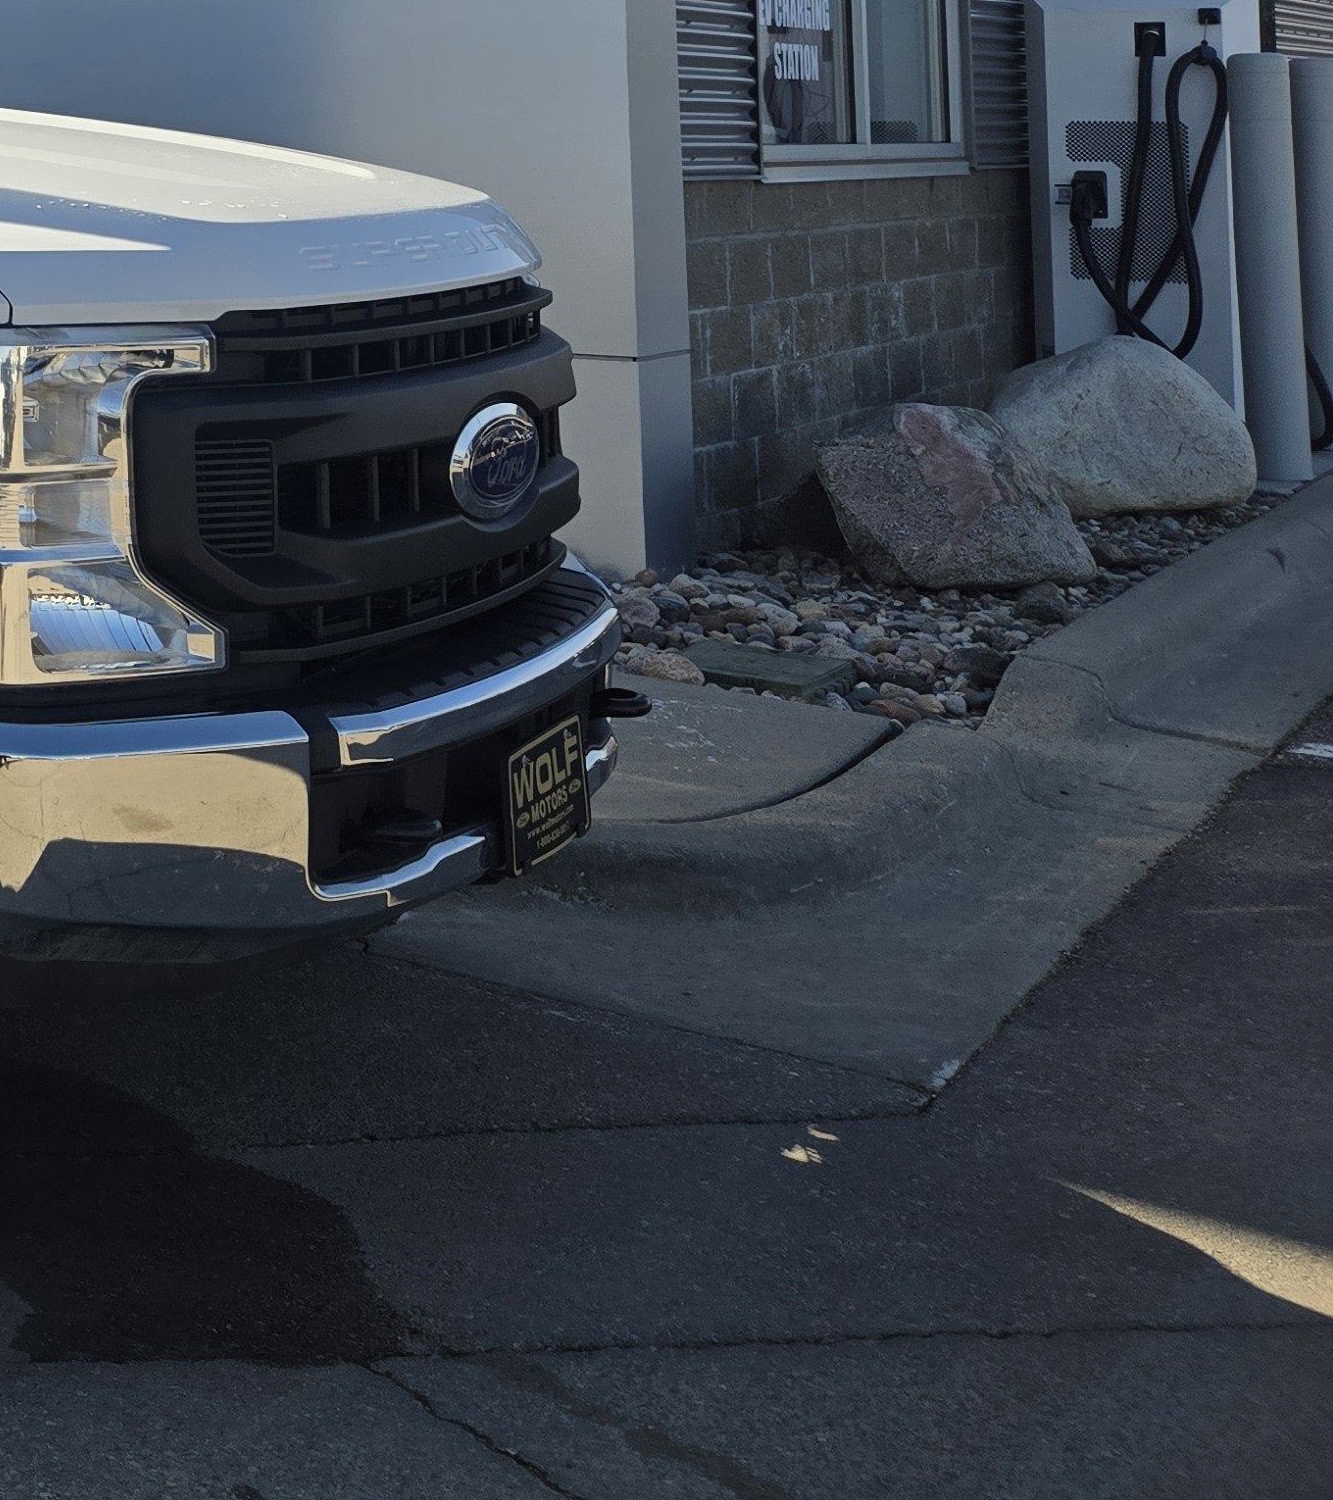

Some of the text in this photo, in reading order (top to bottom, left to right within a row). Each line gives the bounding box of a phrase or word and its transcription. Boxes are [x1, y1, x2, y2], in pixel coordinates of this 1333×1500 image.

[773, 41, 819, 82] STATION
[513, 734, 579, 809] WOLF
[531, 784, 568, 823] MOTORS
